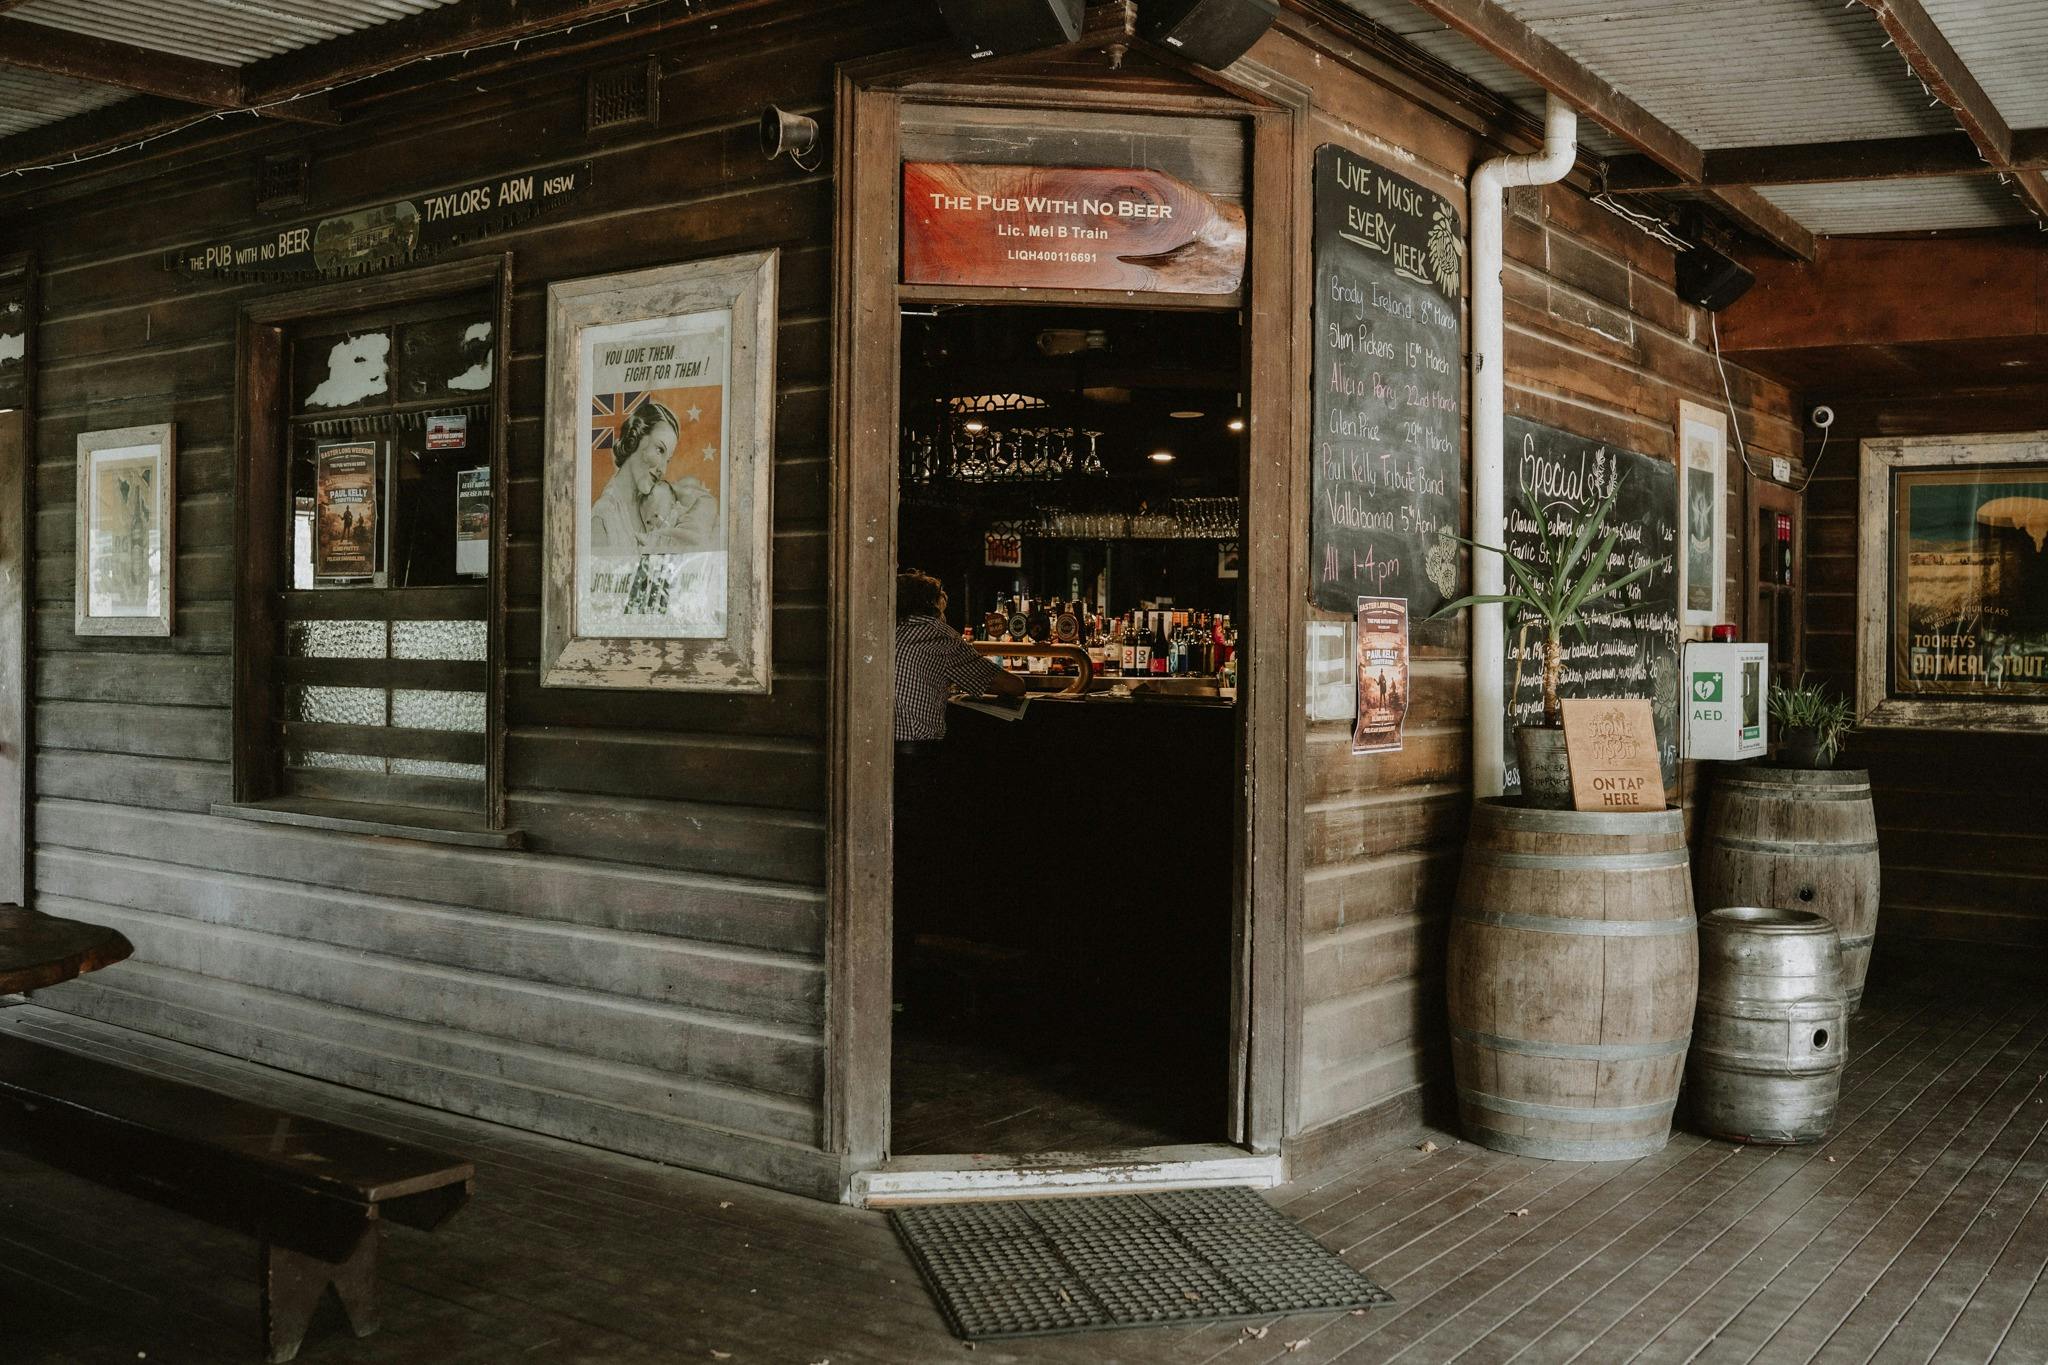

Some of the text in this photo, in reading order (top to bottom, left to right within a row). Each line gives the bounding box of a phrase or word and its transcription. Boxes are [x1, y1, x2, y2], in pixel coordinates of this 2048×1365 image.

[930, 193, 1173, 219] THE PUB WITH NO BEER
[189, 174, 574, 271] THE PUB WITH NO BEER TAYLORS ARM NSW
[998, 225, 1109, 240] Lic. Mel B Train
[1008, 250, 1097, 264] LIQH400116691
[1394, 242, 1428, 279] WEEK
[1331, 275, 1364, 320] Brody
[1371, 282, 1412, 319] Ireland
[1434, 305, 1457, 333] March
[605, 349, 622, 366] YOU
[624, 347, 646, 364] LOVE
[1329, 322, 1354, 352] Slim
[1359, 324, 1394, 360] Pickens
[1425, 348, 1449, 375] March
[624, 365, 651, 382] FIGHT
[654, 364, 671, 380] FOR
[1330, 362, 1364, 396] Alicia
[1431, 390, 1456, 412] March
[1330, 408, 1357, 436] Glen
[1359, 411, 1380, 441] Price
[1425, 427, 1453, 453] March
[1323, 442, 1444, 497] Paul Kelly Tribute Band
[330, 488, 368, 499] PAUL KELLY
[1415, 509, 1436, 541] April
[1323, 542, 1339, 583] All
[590, 573, 632, 593] JOIN THE
[1984, 606, 2009, 617] GLASS
[1915, 634, 1976, 648] TOOHEYS
[1367, 649, 1398, 660] PAUL KELLY
[1913, 655, 2045, 677] OATMEAL STOUT
[1693, 710, 1723, 720] AED
[1593, 777, 1645, 790] ON TAP
[1603, 792, 1640, 806] HERE
